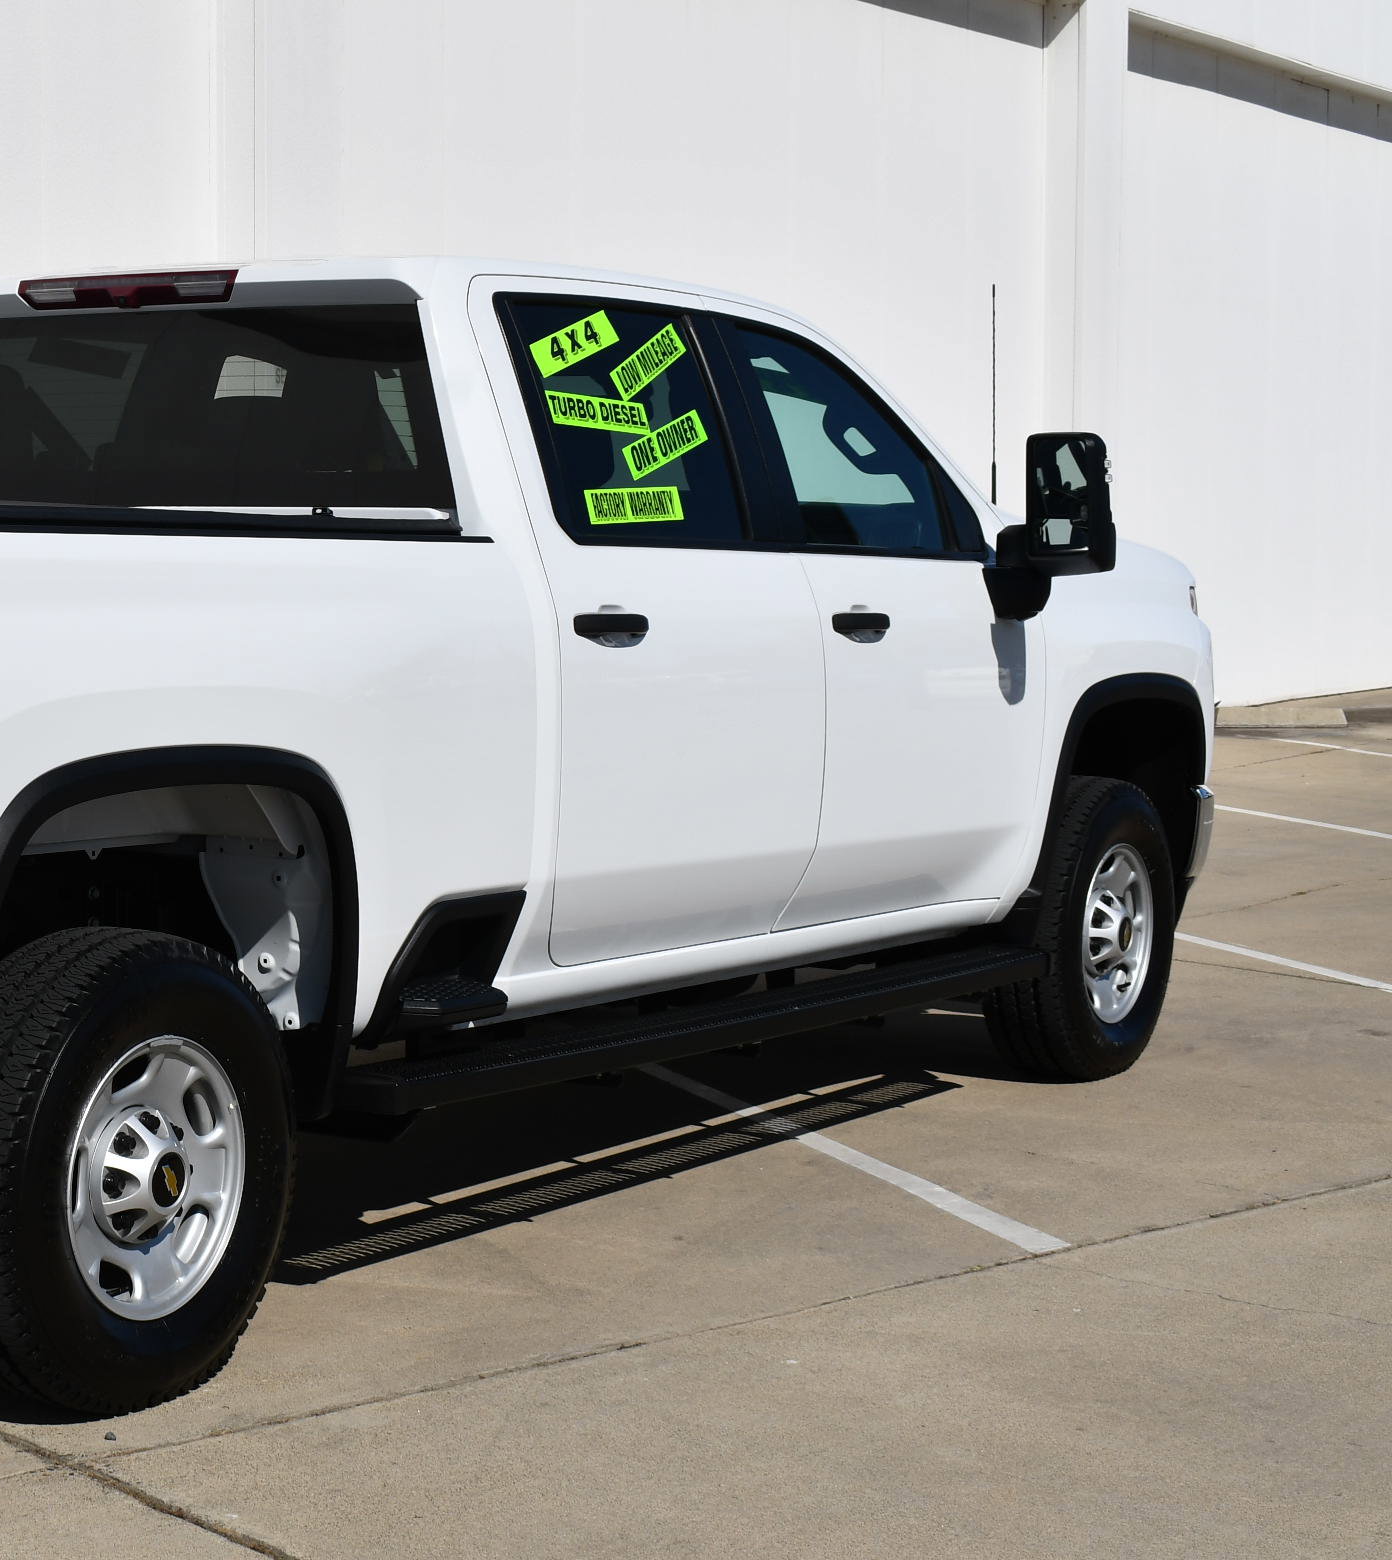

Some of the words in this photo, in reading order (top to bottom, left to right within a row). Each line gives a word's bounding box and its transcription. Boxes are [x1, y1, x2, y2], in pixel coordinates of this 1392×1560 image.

[615, 358, 643, 394] LOW
[636, 329, 680, 378] MILEAGE
[549, 395, 596, 420] TURBO
[600, 402, 646, 427] DIESEL
[630, 437, 659, 472] ONE
[656, 415, 699, 457] OWNER
[590, 492, 627, 519] FACTORY
[626, 490, 676, 517] WARRANTY
